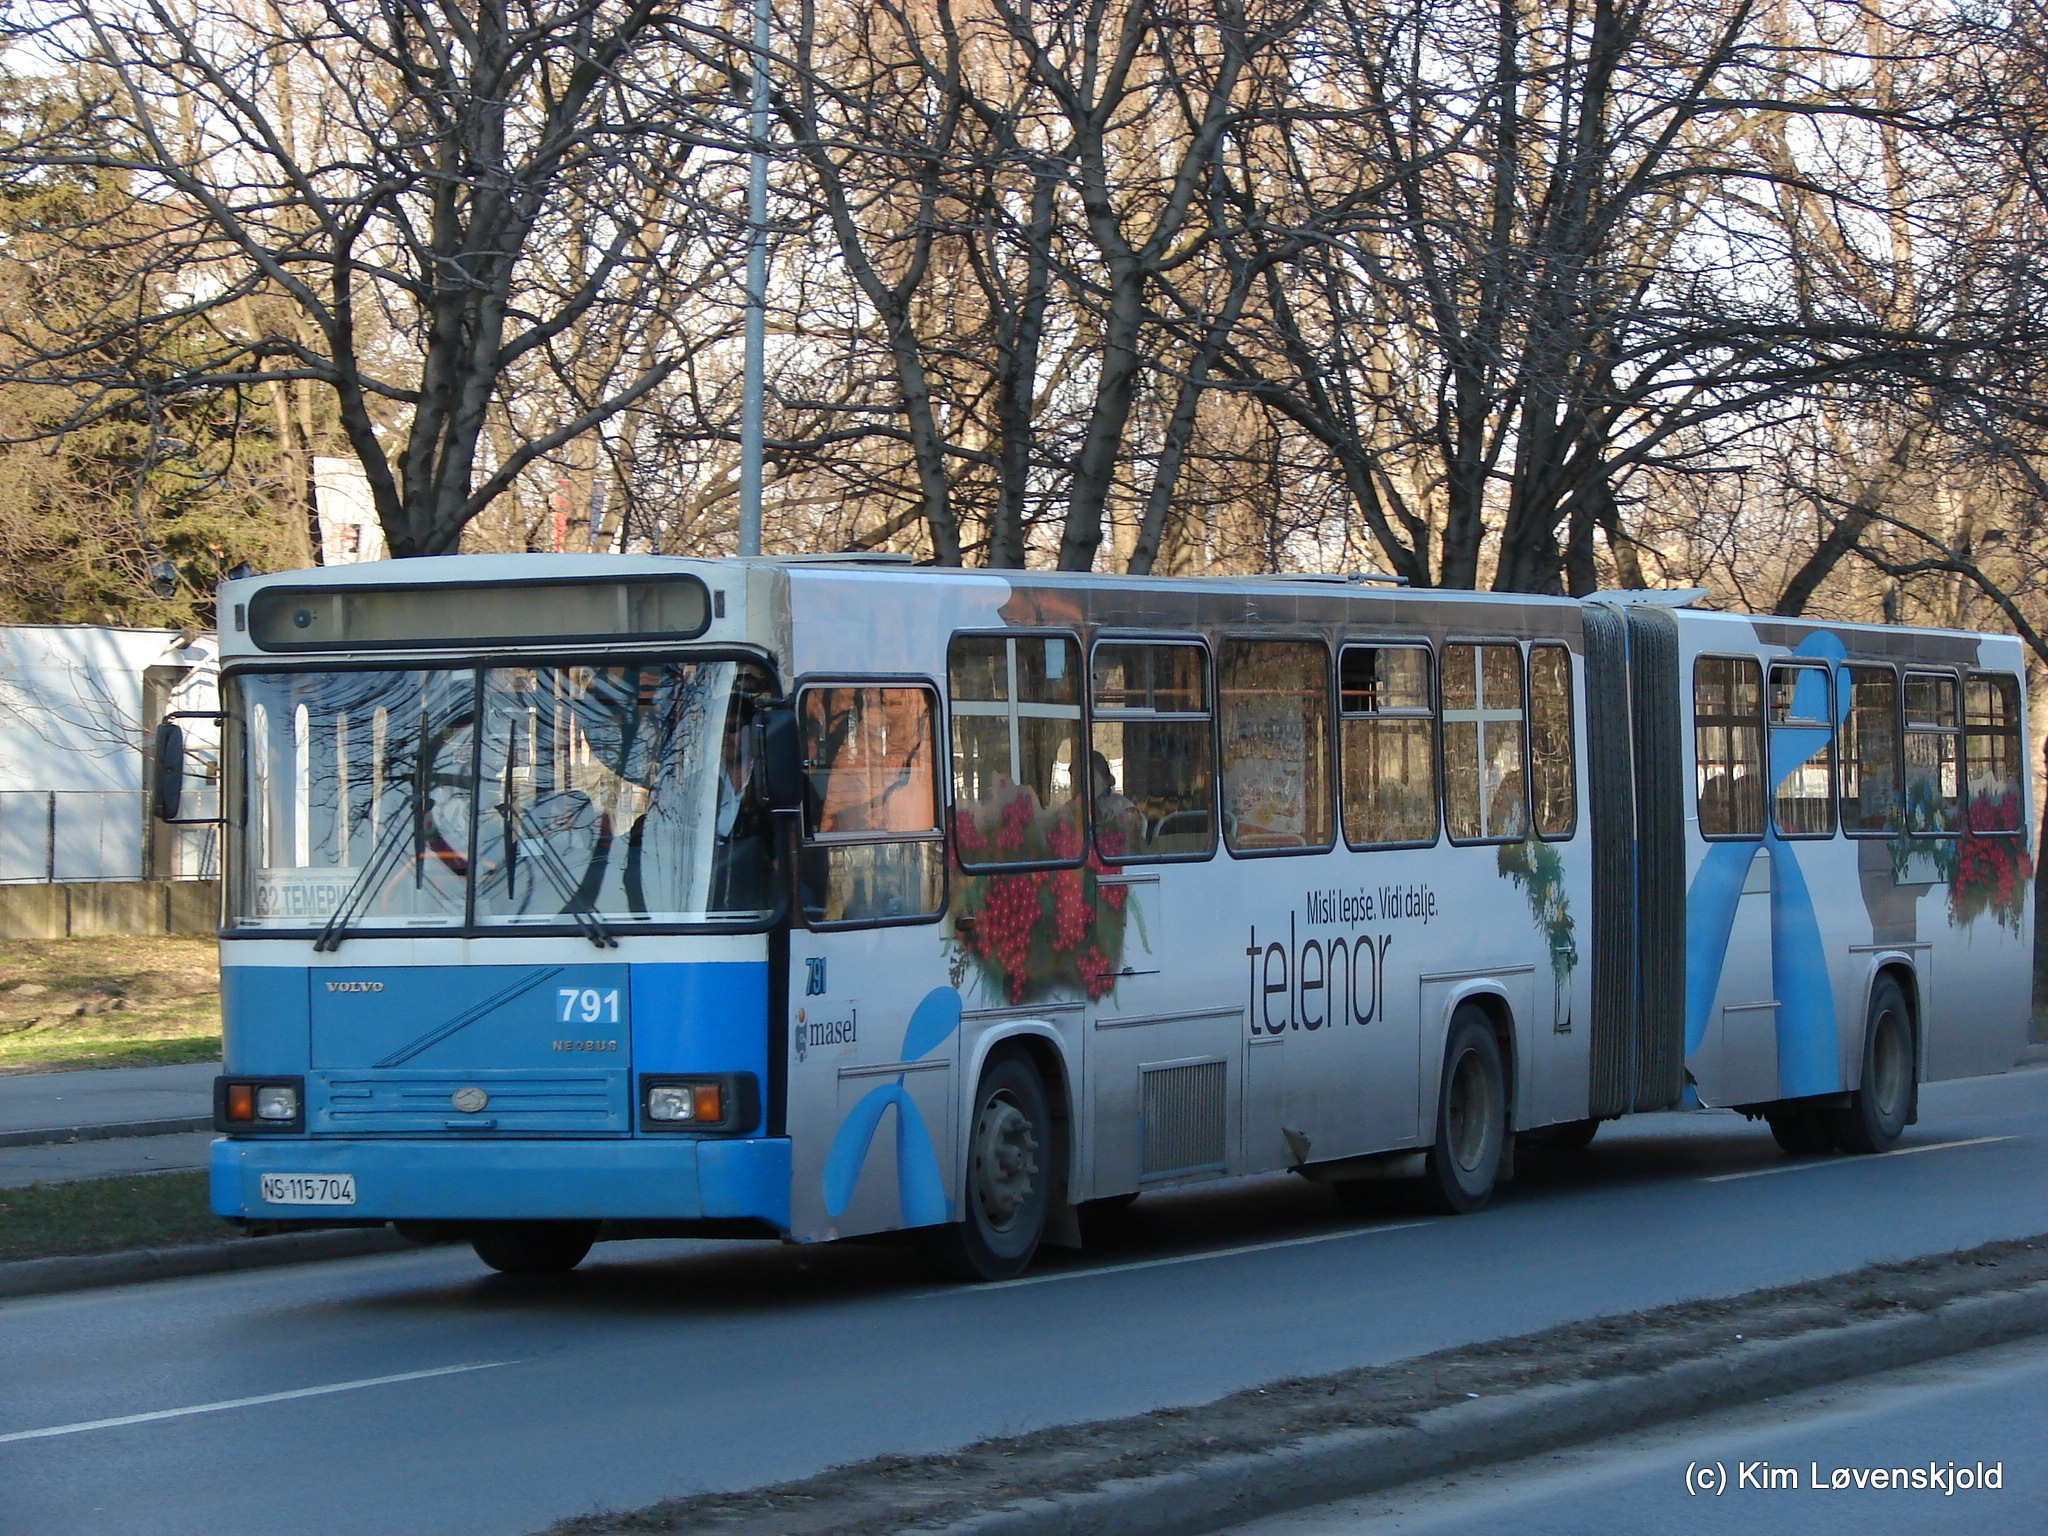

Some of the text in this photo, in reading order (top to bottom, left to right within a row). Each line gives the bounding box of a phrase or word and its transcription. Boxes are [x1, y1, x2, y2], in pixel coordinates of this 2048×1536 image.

[258, 885, 280, 915] 32
[1306, 883, 1438, 930] Misli lepše. Vidi dalje.
[325, 981, 385, 993] VOLVO
[805, 957, 827, 996] 791
[1246, 910, 1392, 1035] telenor
[559, 989, 619, 1023] 791
[553, 1040, 617, 1052] NEOBUS
